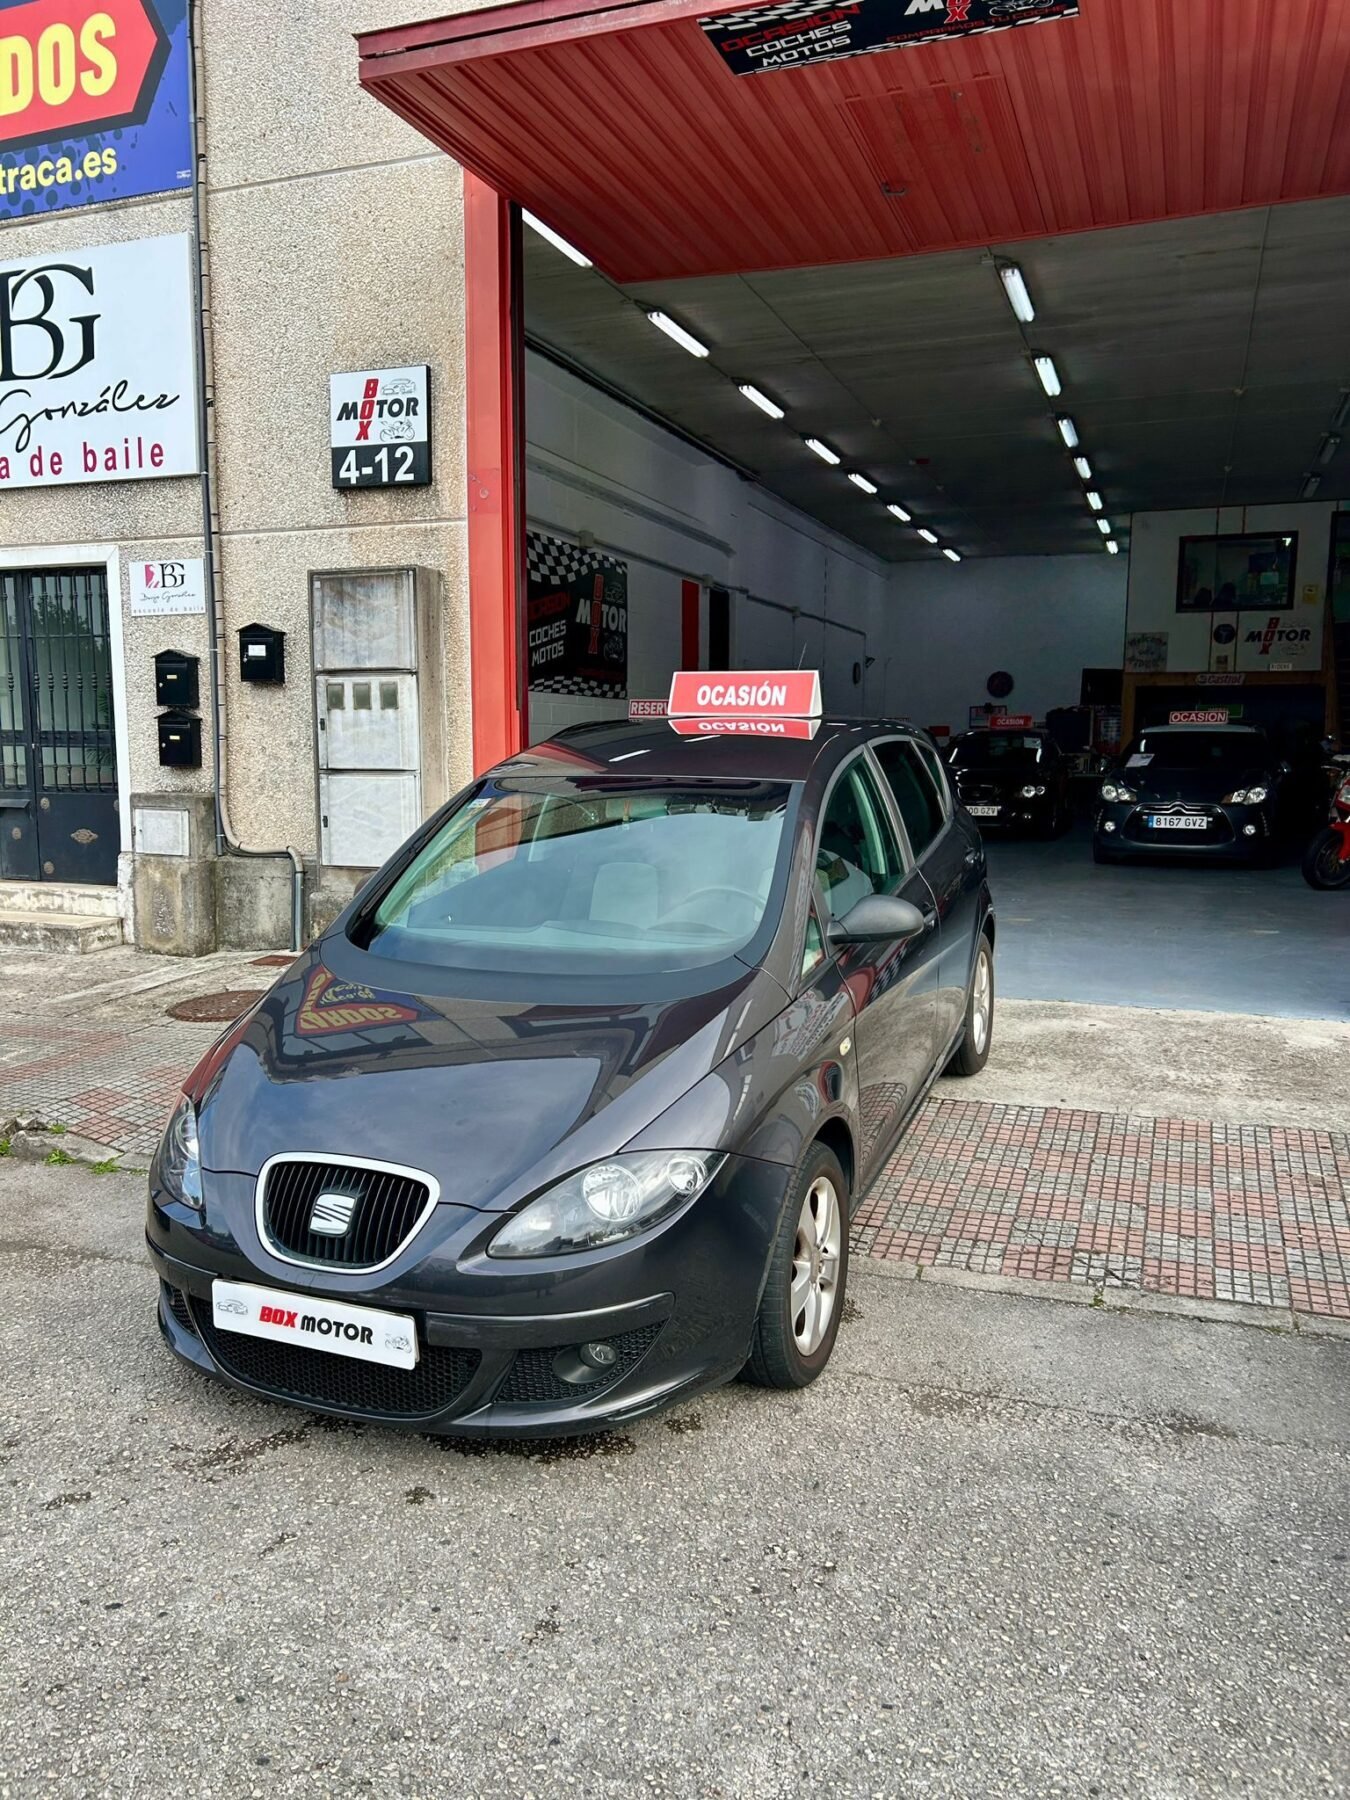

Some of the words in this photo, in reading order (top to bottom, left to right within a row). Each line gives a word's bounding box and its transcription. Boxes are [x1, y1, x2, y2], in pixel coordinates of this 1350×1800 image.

[746, 20, 852, 57] COCHES
[762, 35, 851, 67] MOTOS
[0, 12, 117, 117] DOS
[336, 397, 419, 421] MOTOR
[355, 378, 379, 441] BOX
[29, 445, 63, 477] de
[83, 436, 164, 472] baile
[339, 445, 415, 485] 4-12
[159, 562, 186, 588] BG
[575, 597, 627, 633] MOTOR
[529, 619, 567, 647] COCHES
[1245, 629, 1311, 642] MOTOR
[531, 640, 565, 667] MOTOS
[1207, 674, 1242, 685] Castrol
[696, 681, 787, 707] OCASIÓN
[1171, 712, 1227, 722] OCASION
[1155, 817, 1182, 827] 8167
[1184, 817, 1205, 828] GVZ
[258, 1305, 298, 1329] BOX
[300, 1314, 374, 1345] MOTOR
